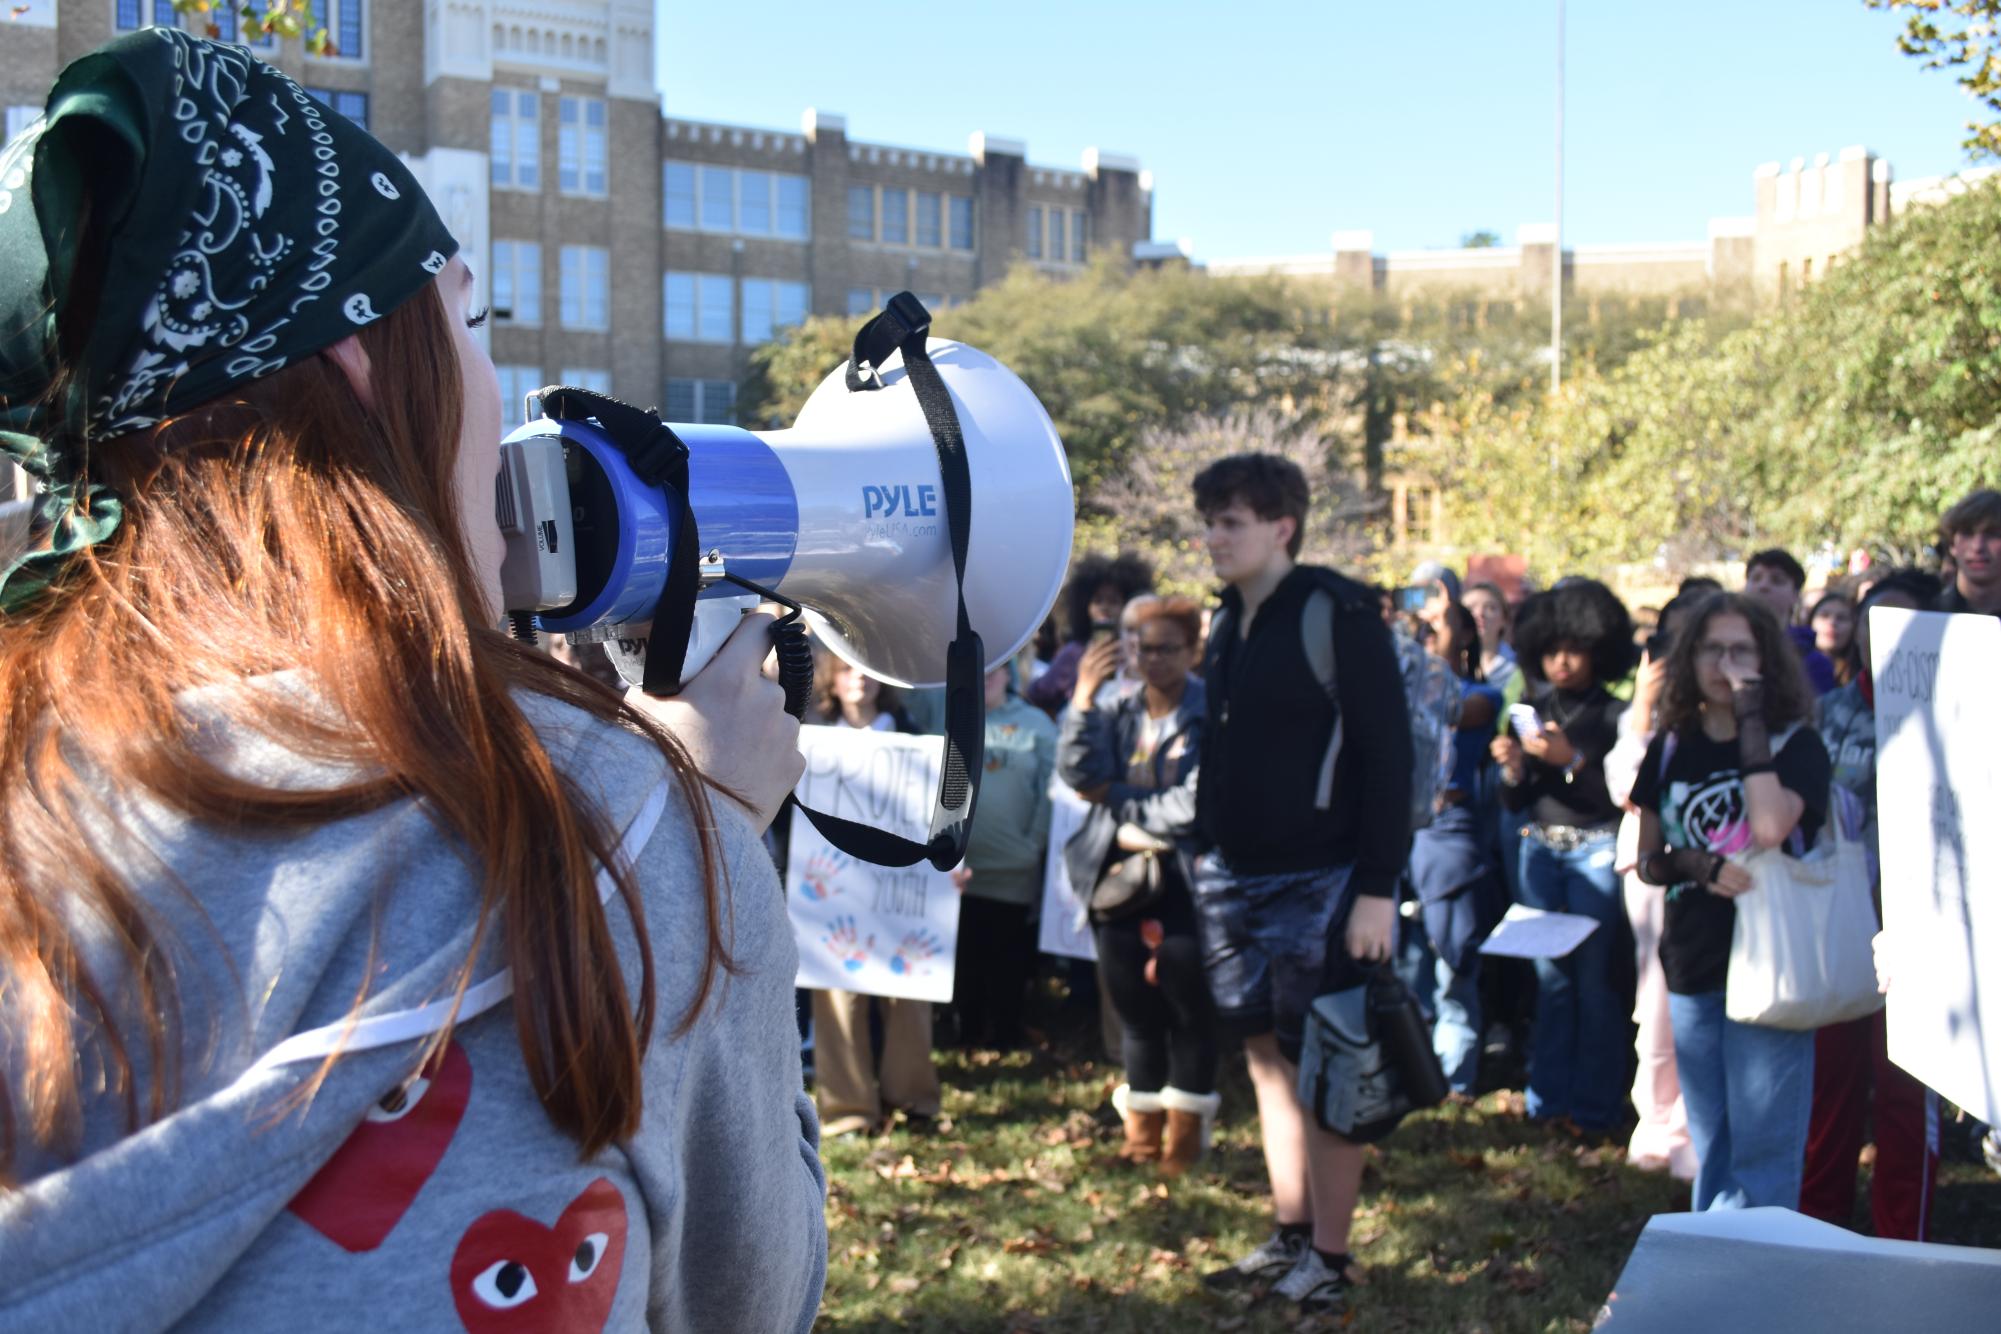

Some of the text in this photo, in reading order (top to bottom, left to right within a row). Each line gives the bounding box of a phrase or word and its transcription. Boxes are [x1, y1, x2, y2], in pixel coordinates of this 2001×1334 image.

[862, 485, 936, 519] PYLE
[537, 524, 545, 552] VOLUME
[871, 871, 929, 918] YOUTH
